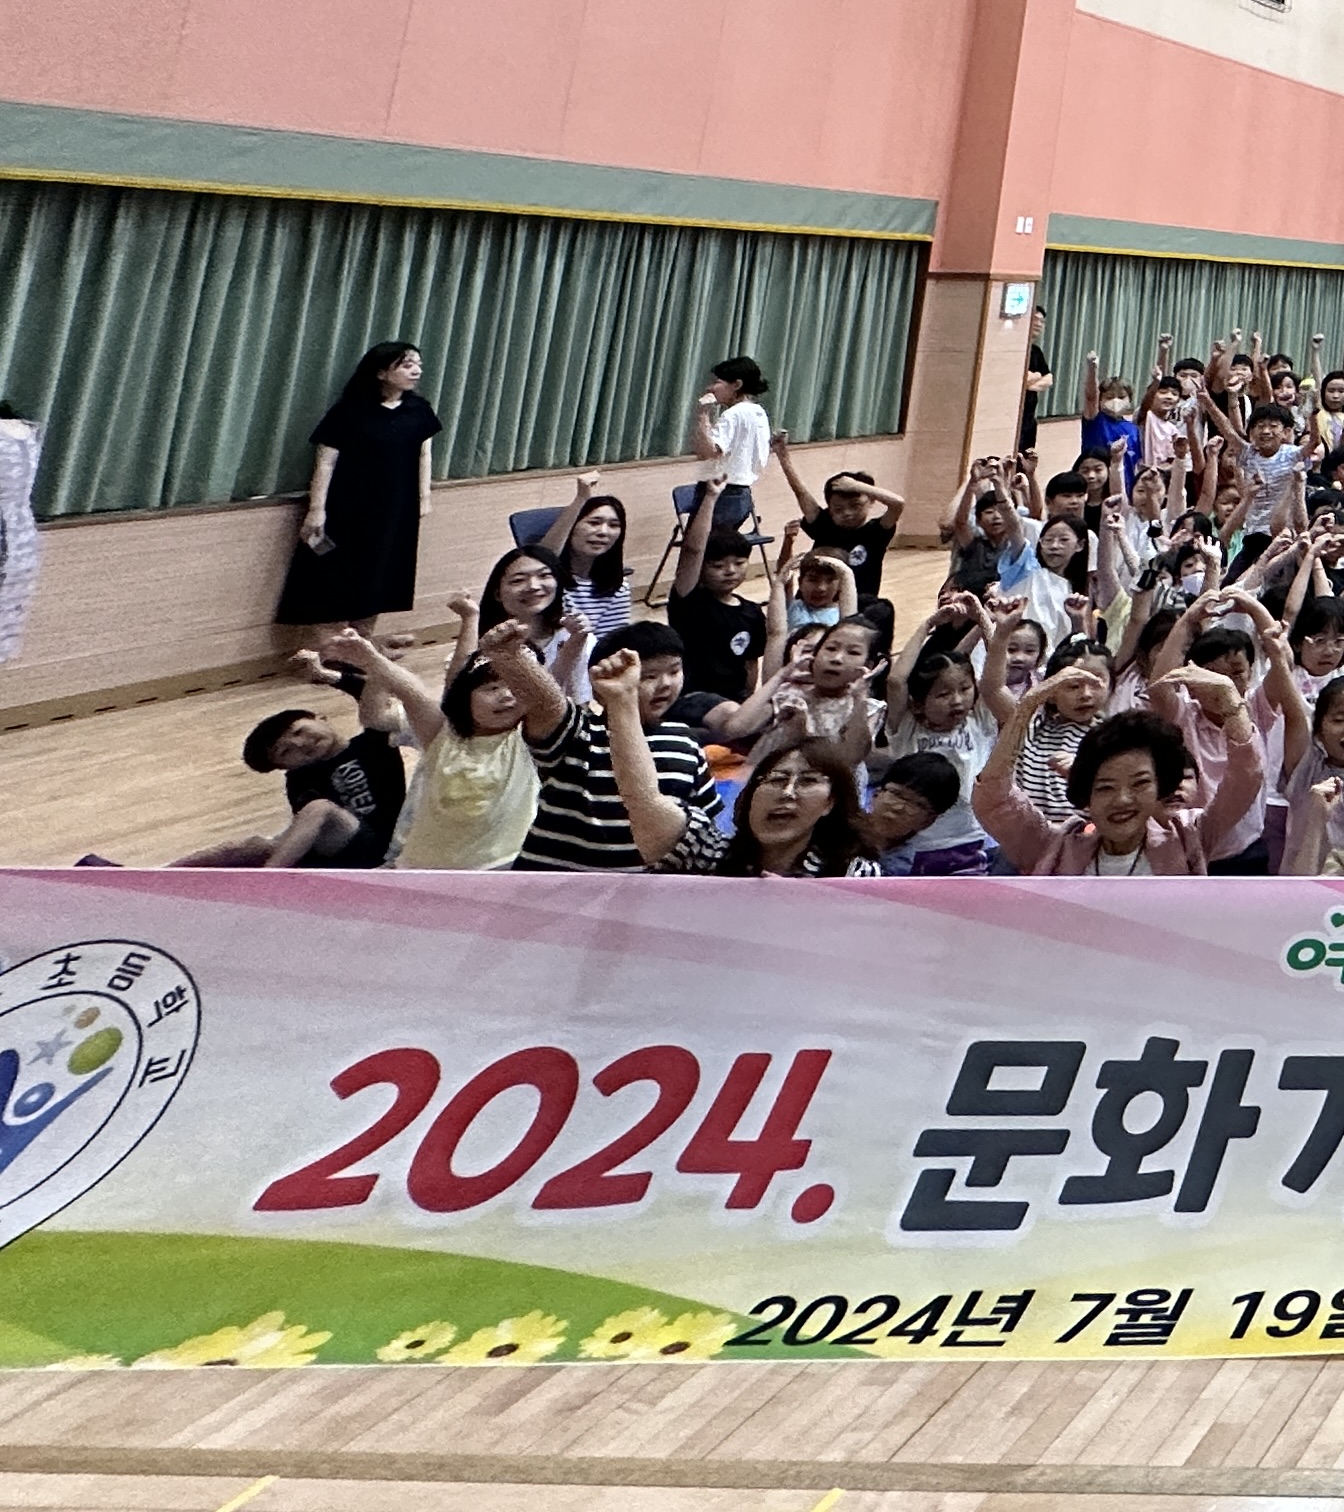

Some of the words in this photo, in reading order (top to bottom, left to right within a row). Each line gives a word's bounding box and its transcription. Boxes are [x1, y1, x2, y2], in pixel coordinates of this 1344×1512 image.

[0, 951, 190, 1089] 초등학교
[253, 1044, 836, 1226] 2024.
[722, 1289, 1036, 1348] 2024년
[1054, 1287, 1194, 1347] 7월
